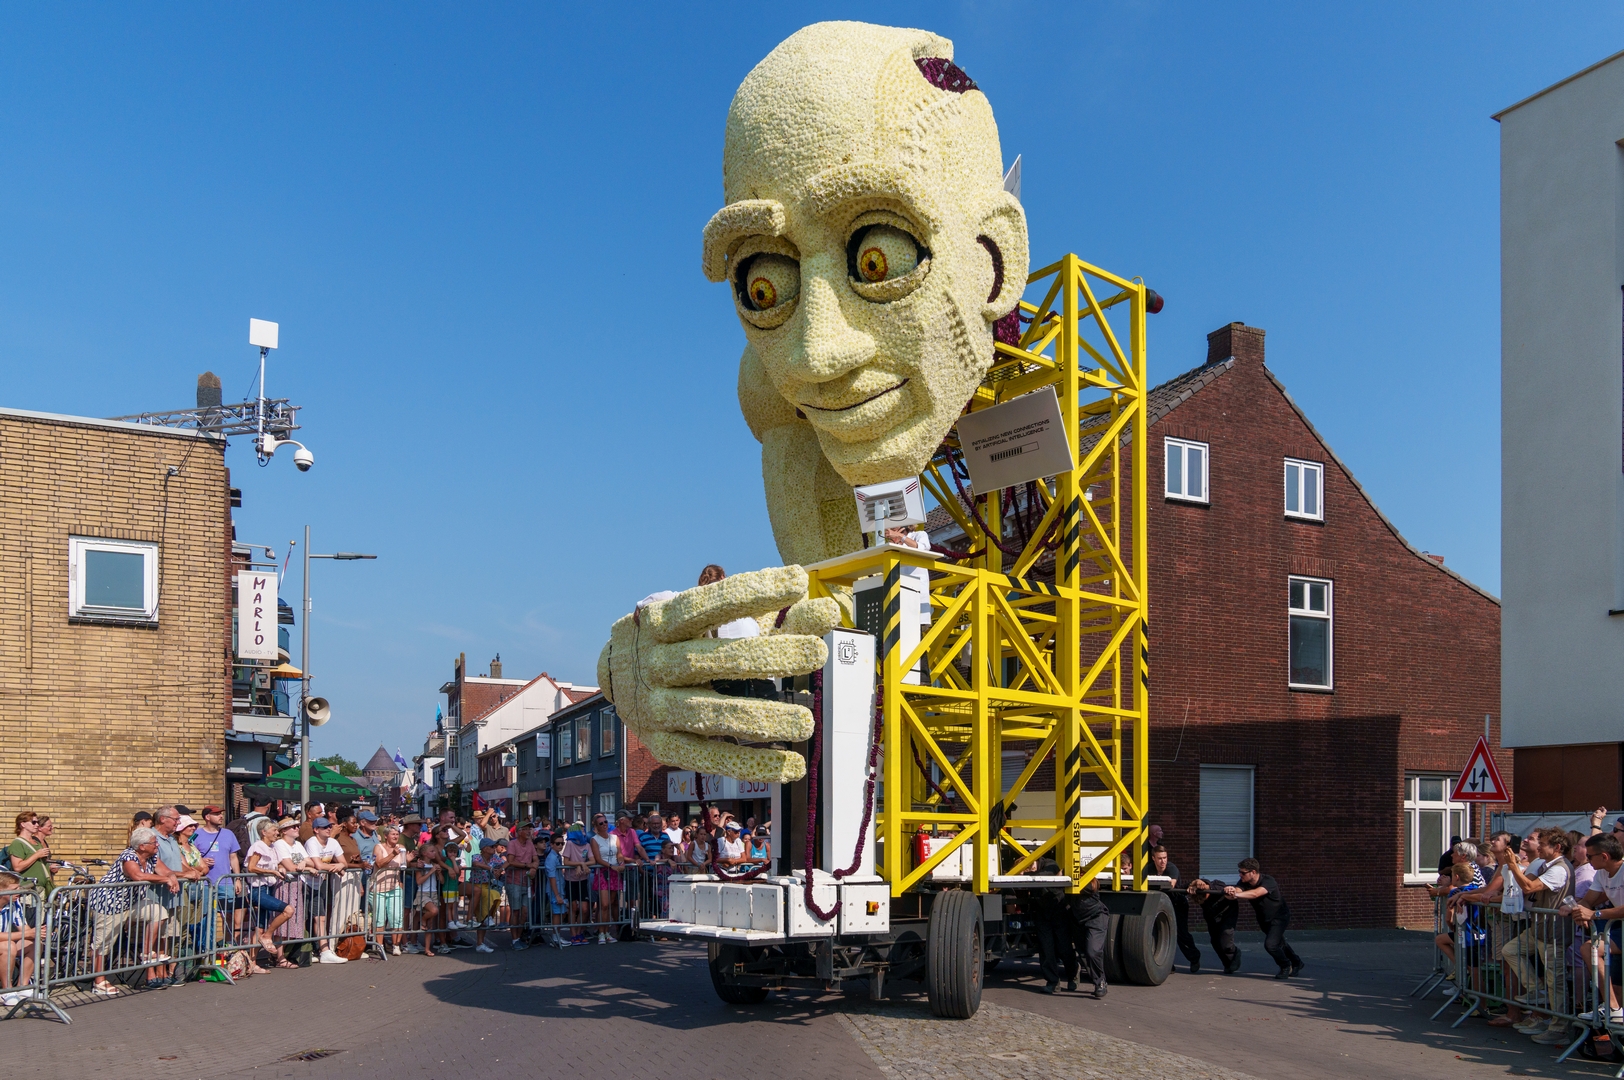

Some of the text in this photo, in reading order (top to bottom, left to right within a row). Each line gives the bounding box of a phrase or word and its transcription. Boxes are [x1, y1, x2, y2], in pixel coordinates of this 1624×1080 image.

[971, 419, 1050, 446] INITIALIZING NEW CONNECTIONS
[982, 438, 1008, 449] ARTIFICIAL
[1008, 426, 1044, 441] INTELLIGENCE
[253, 577, 266, 645] MARLO
[247, 780, 372, 796] eieken
[689, 775, 711, 796] LCK
[1072, 822, 1080, 888] LENT LABS
